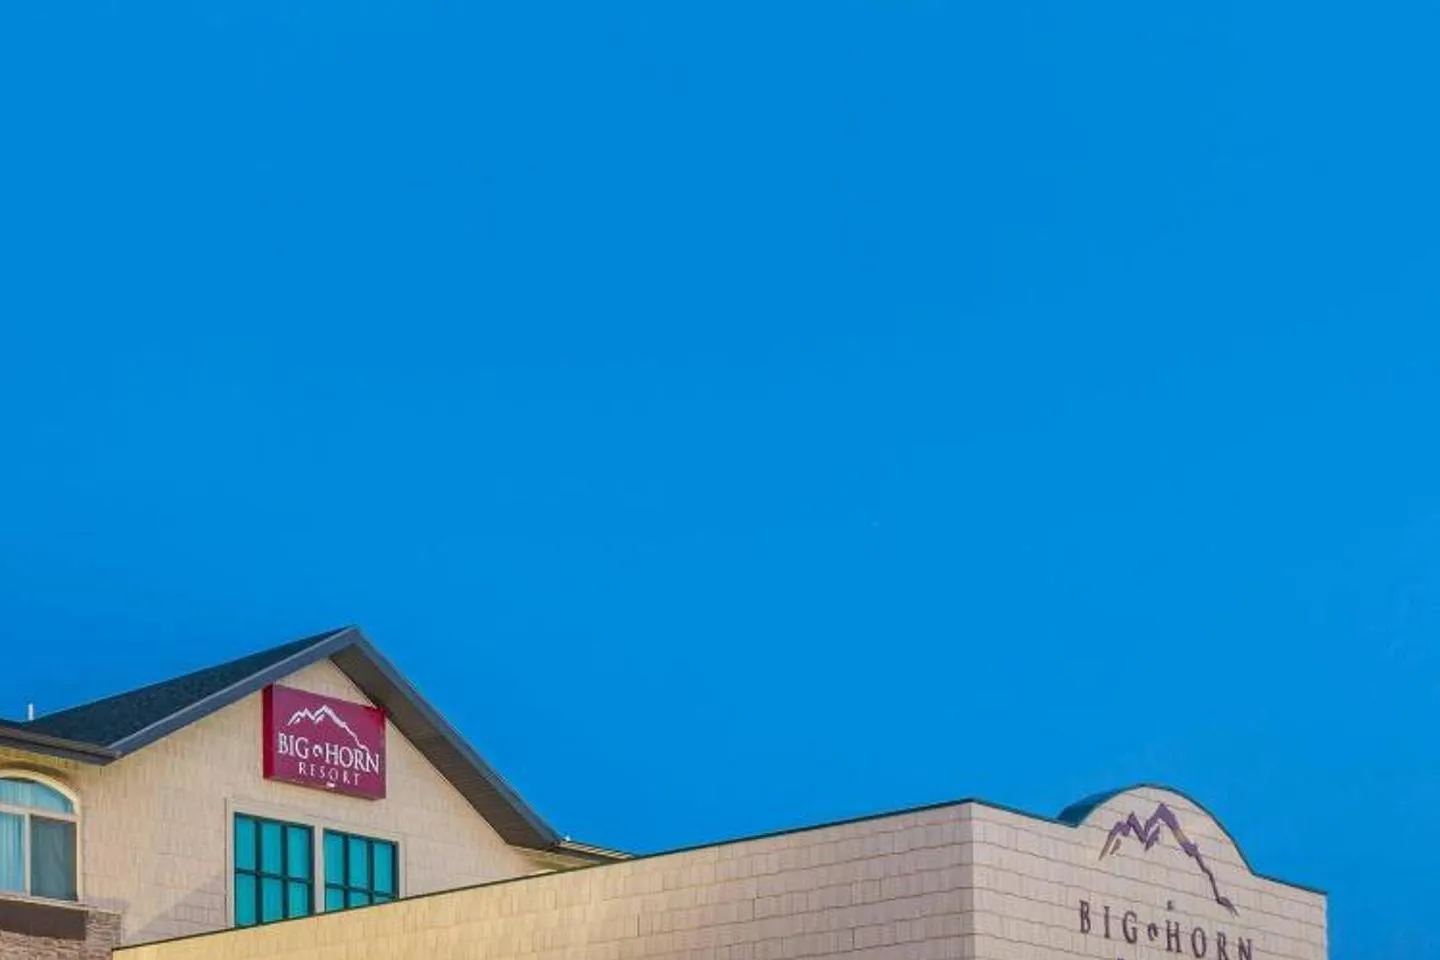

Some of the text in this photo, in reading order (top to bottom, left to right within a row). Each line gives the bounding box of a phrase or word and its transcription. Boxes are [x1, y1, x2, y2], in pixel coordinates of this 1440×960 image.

[278, 731, 380, 774] BIG HORN
[298, 761, 361, 786] RESORT
[1079, 900, 1138, 944] BIG
